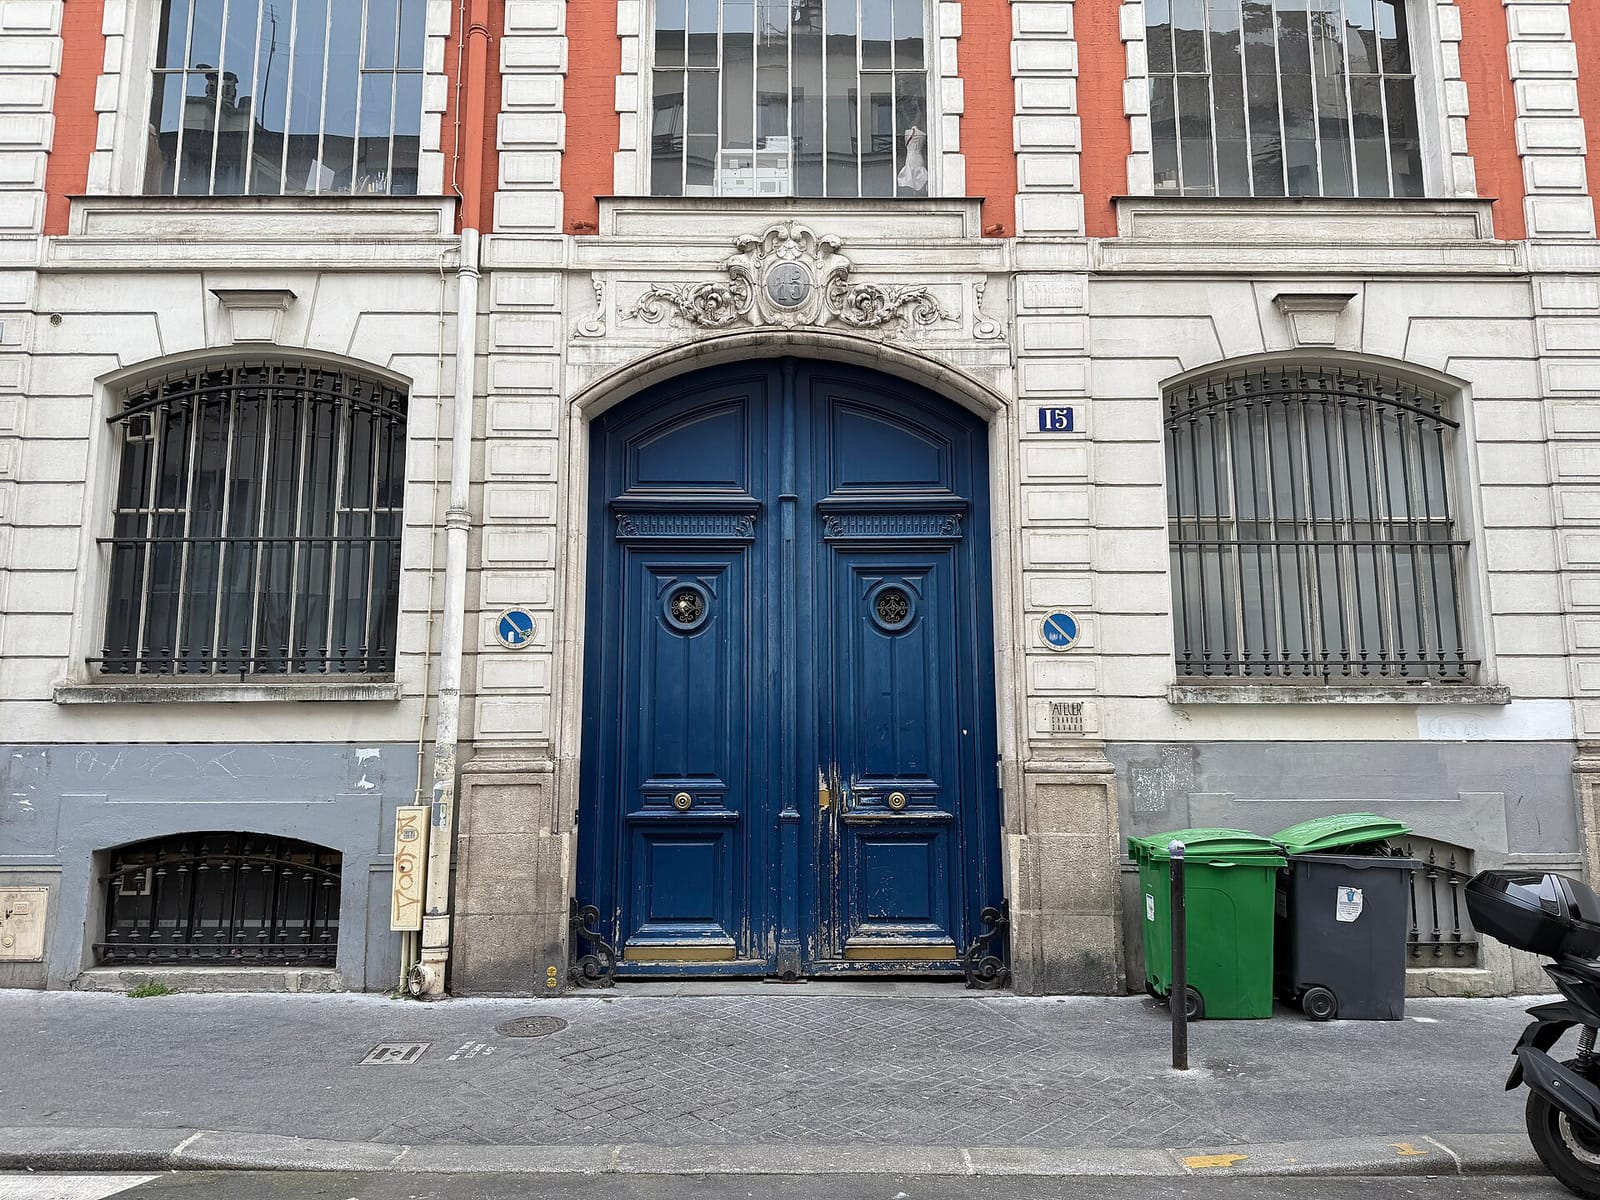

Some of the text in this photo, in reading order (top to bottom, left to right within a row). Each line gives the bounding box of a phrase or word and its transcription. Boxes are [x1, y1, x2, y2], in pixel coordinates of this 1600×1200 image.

[776, 269, 804, 301] 15
[1045, 409, 1067, 429] 15
[1052, 702, 1082, 716] ATELIER
